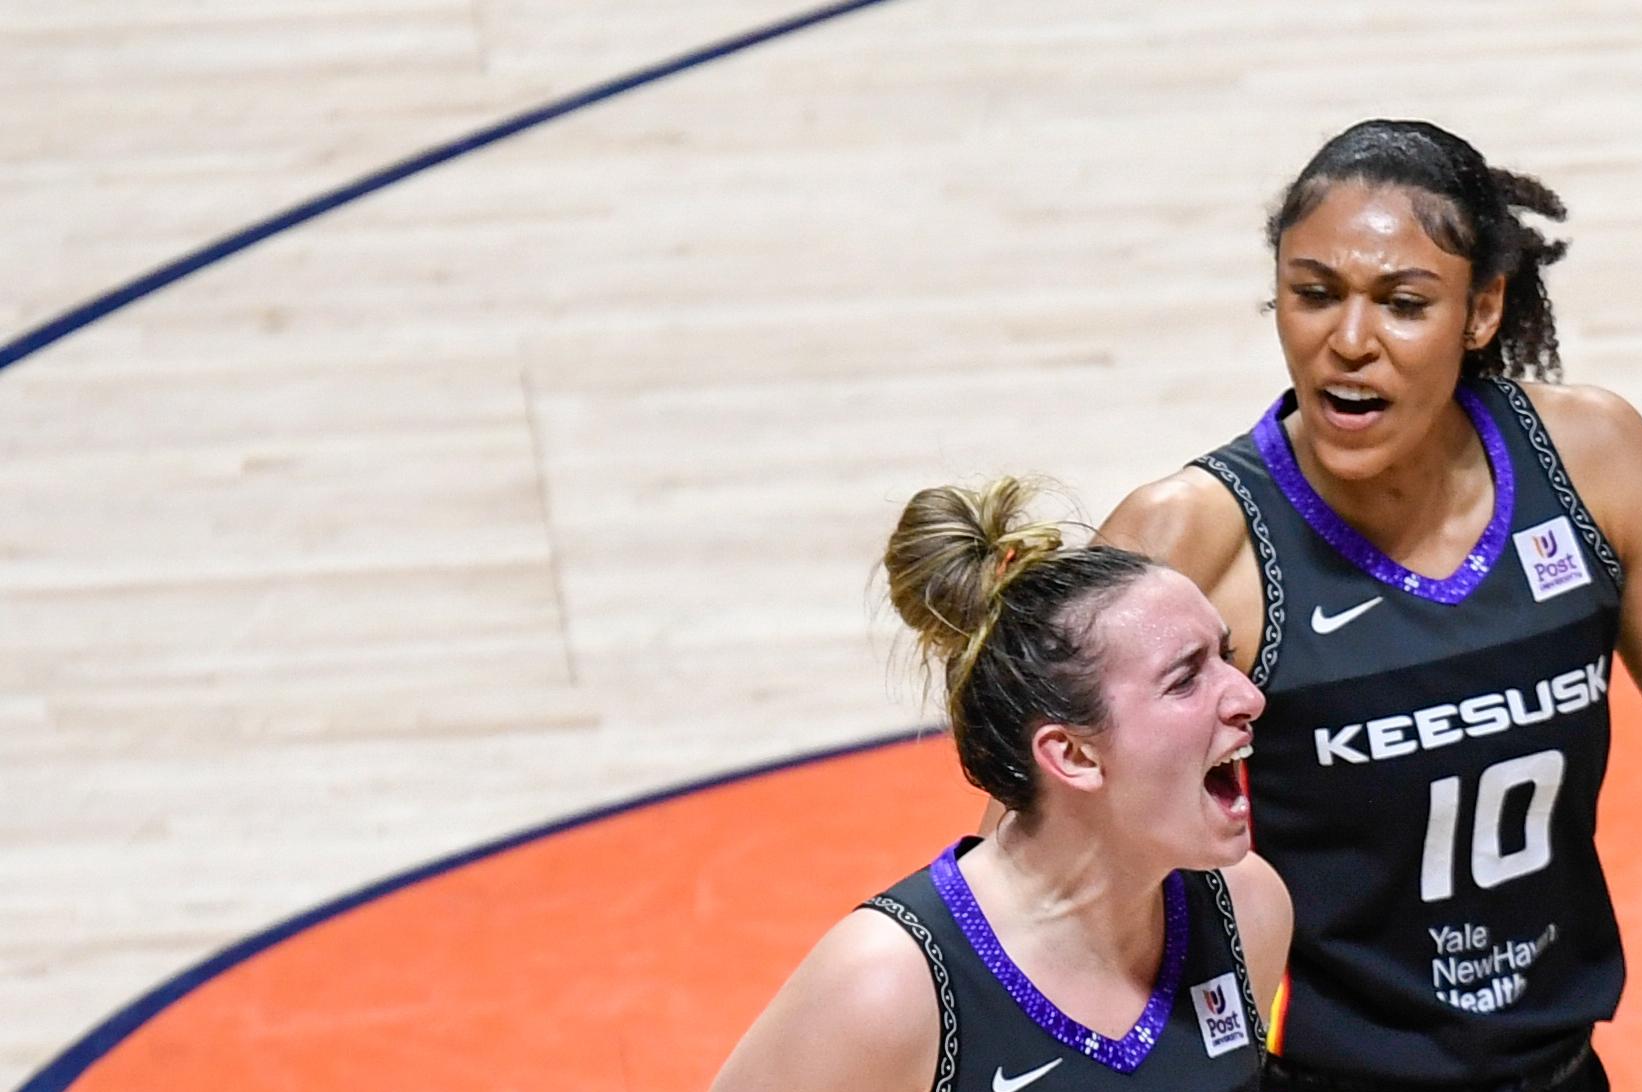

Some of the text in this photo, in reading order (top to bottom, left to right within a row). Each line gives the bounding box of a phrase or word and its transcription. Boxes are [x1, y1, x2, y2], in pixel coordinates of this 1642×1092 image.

[1534, 554, 1577, 582] Post
[1314, 655, 1607, 766] KEESUSK
[1421, 750, 1564, 901] 10
[1428, 923, 1488, 955] Yale
[1206, 1010, 1240, 1038] Post
